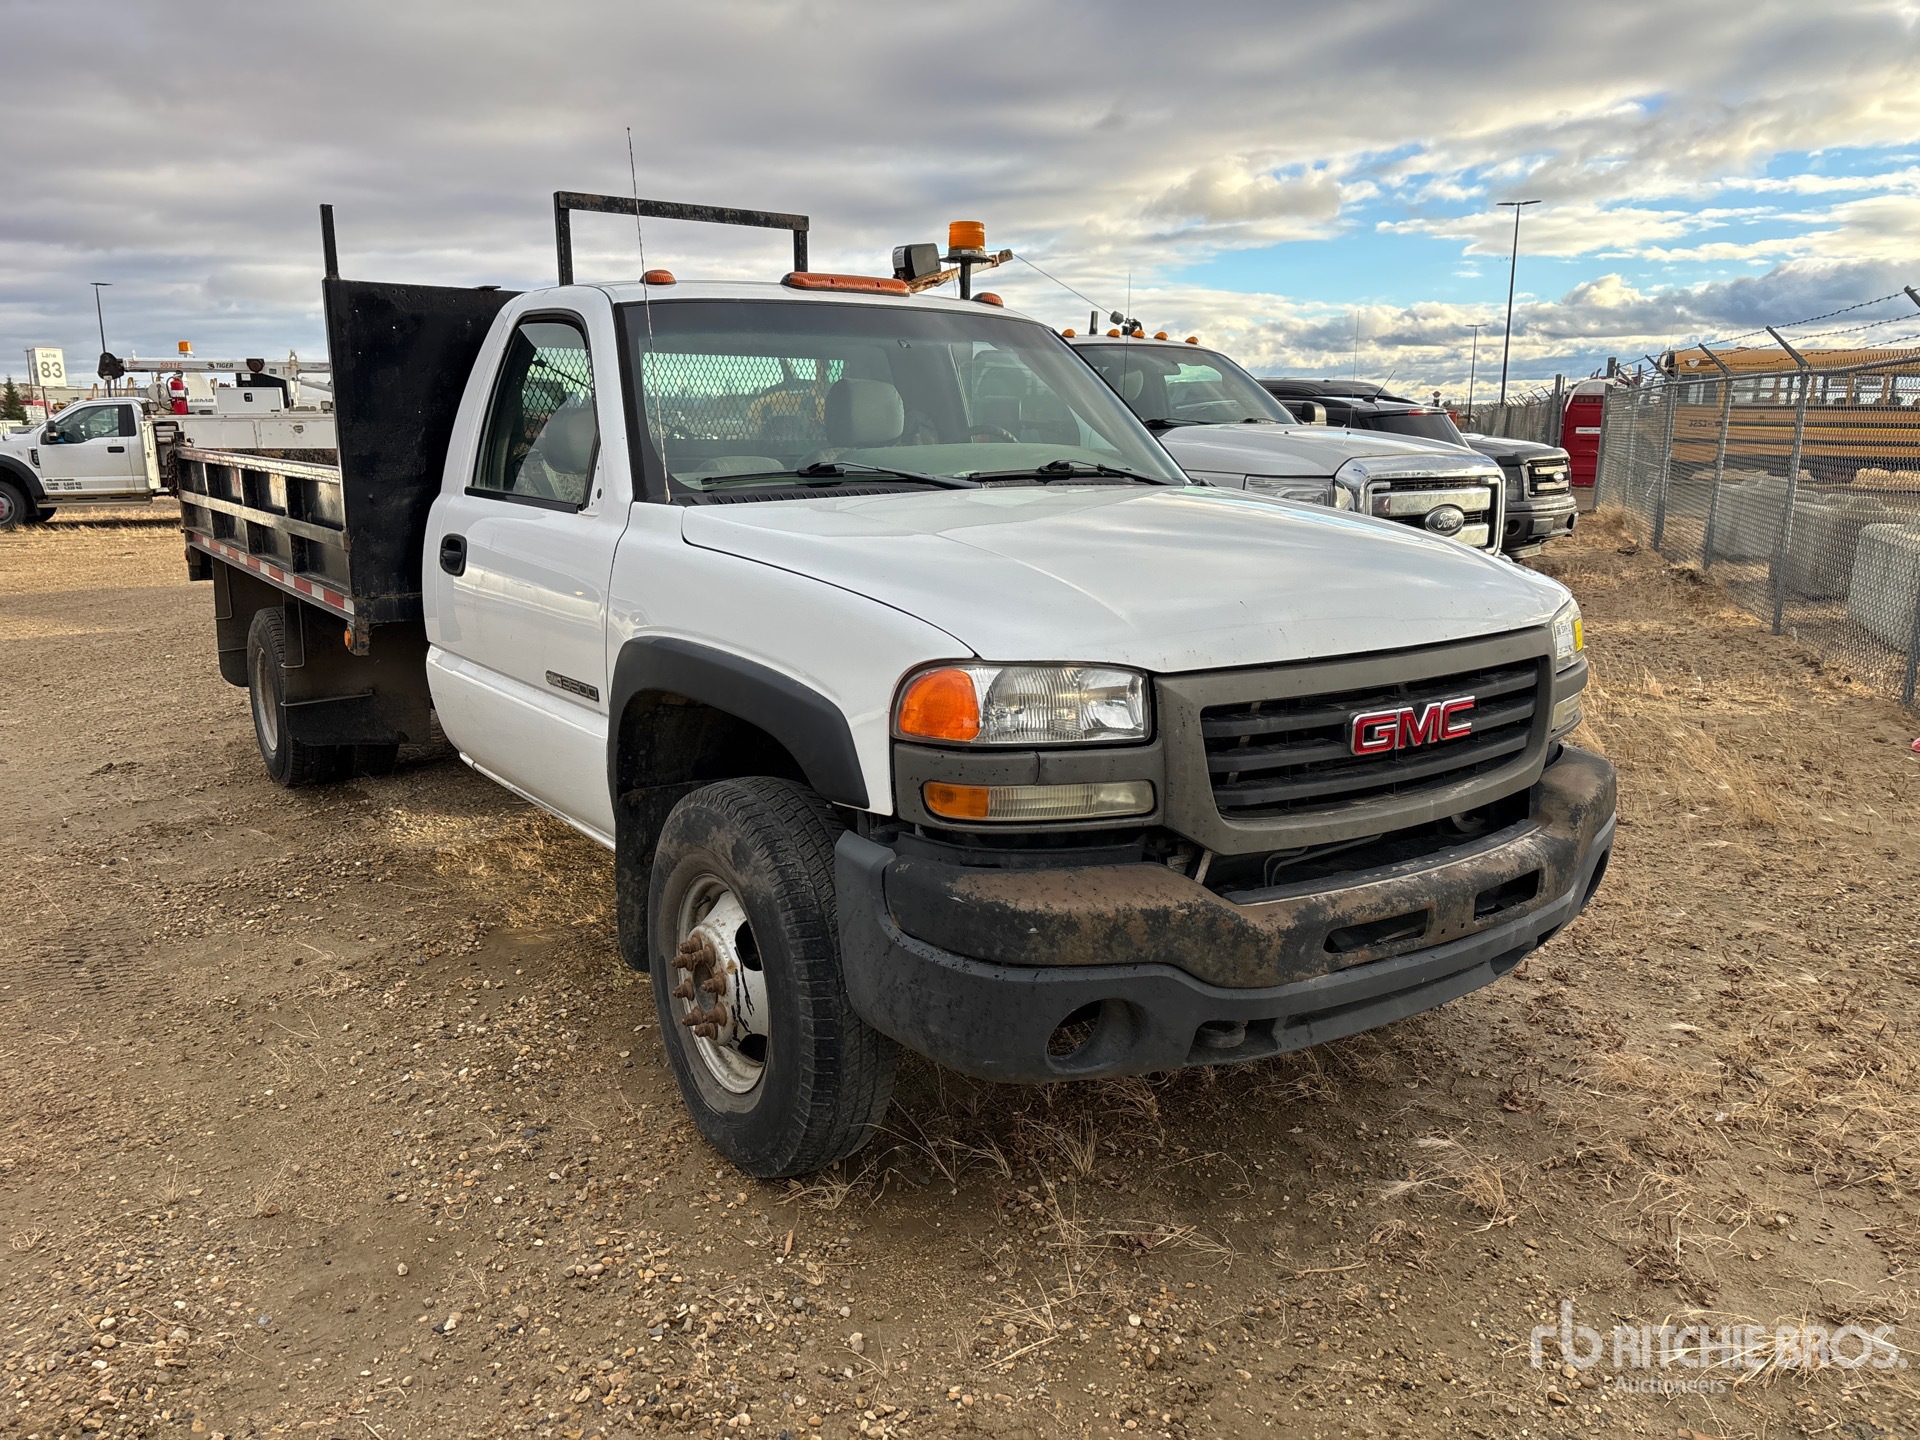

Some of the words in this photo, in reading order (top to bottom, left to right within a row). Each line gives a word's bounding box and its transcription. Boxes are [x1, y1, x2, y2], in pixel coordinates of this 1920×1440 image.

[41, 361, 63, 378] 83
[1436, 512, 1459, 529] Ford
[561, 676, 598, 701] 3500
[1350, 695, 1476, 756] GMC
